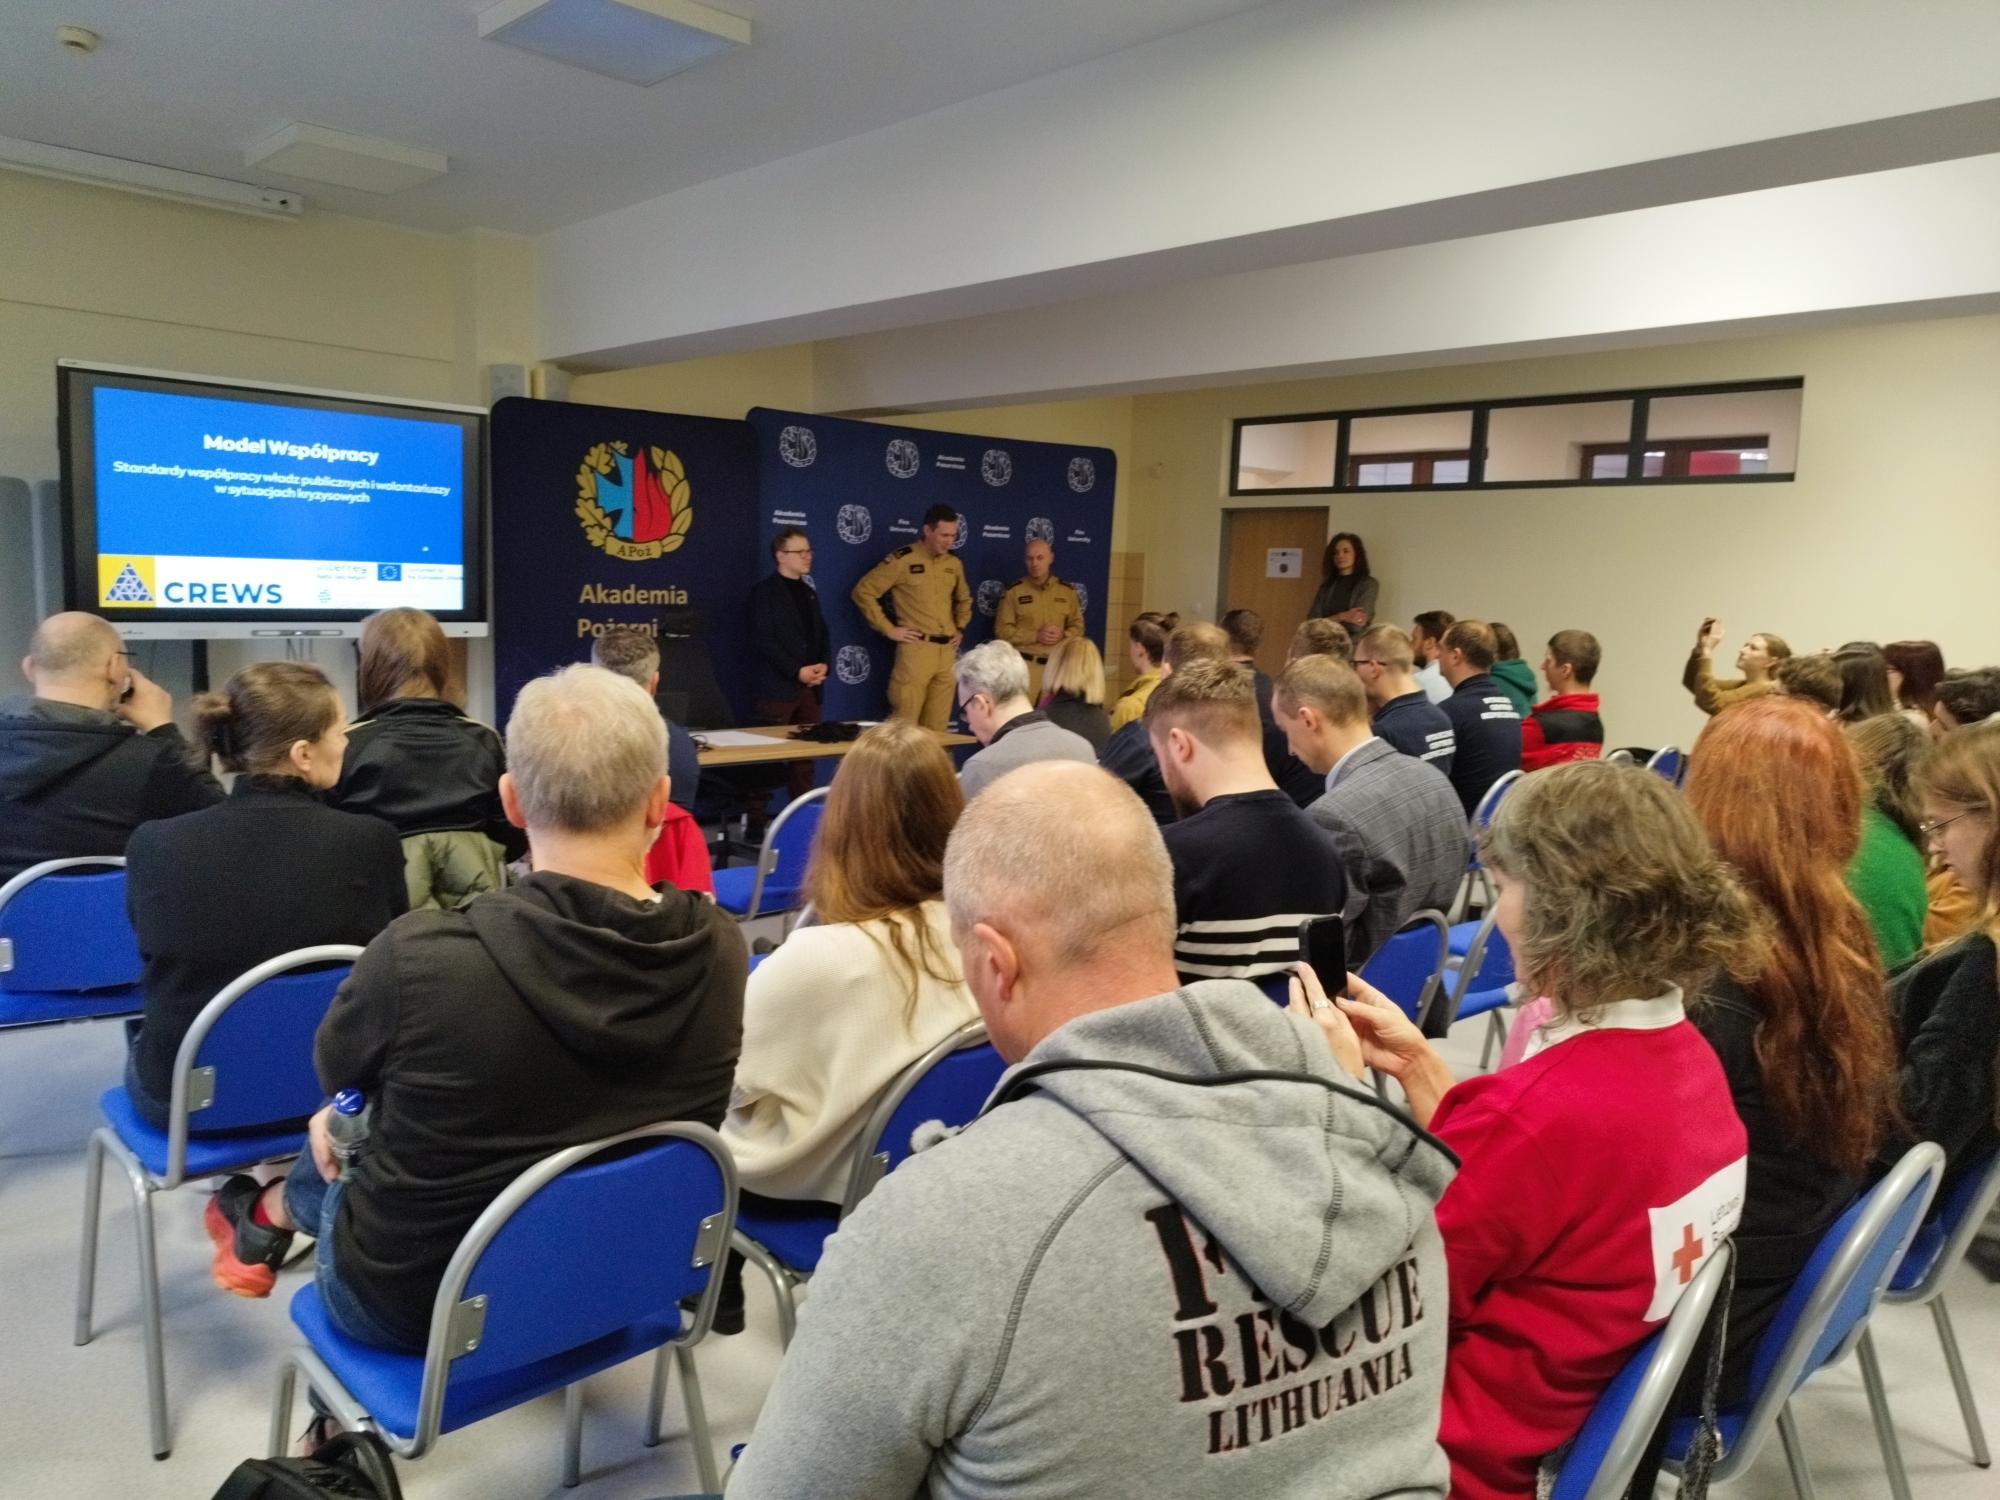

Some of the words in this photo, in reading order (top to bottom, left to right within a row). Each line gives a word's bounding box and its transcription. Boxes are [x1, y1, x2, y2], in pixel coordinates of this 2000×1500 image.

[203, 434, 266, 454] Model
[267, 440, 380, 466] Współpracy
[112, 460, 187, 479] Standardy
[187, 467, 262, 484] współpracy
[300, 474, 370, 490] publicznych
[376, 480, 451, 497] wolontariuszy
[213, 485, 228, 494] w
[227, 484, 297, 499] sytuacjach
[297, 487, 371, 505] kryzysowych
[163, 581, 283, 605] CREWS
[579, 583, 688, 604] Akademia
[1207, 1341, 1414, 1455] LITHUANIA
